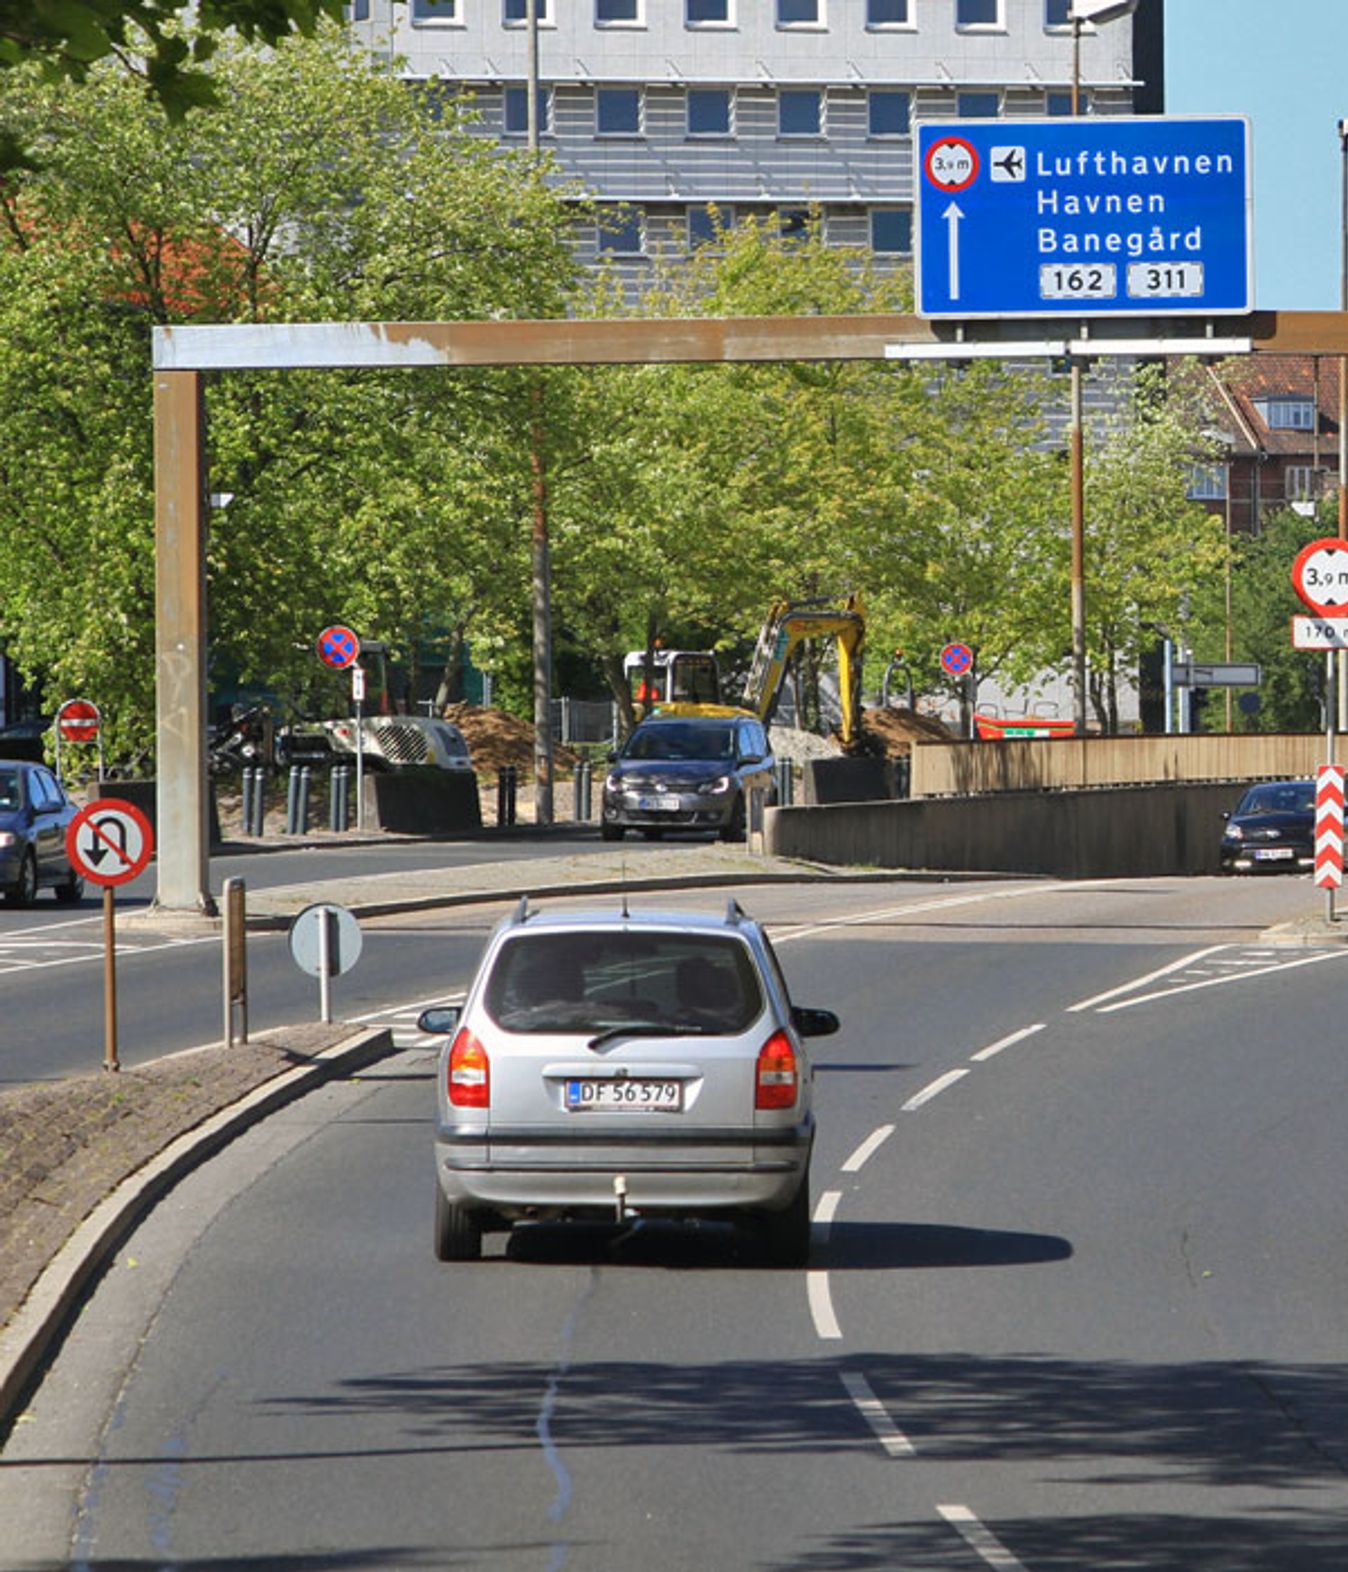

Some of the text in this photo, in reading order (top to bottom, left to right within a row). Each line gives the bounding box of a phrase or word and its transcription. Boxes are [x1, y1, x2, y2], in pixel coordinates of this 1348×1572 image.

[1036, 151, 1233, 177] Lufthavnen
[1037, 190, 1165, 214] Havnen
[1038, 225, 1202, 256] Banegård
[1054, 268, 1186, 291] 162 311
[1306, 568, 1333, 586] 3,9
[1306, 626, 1336, 639] 170
[581, 1082, 676, 1102] DF 56 579
